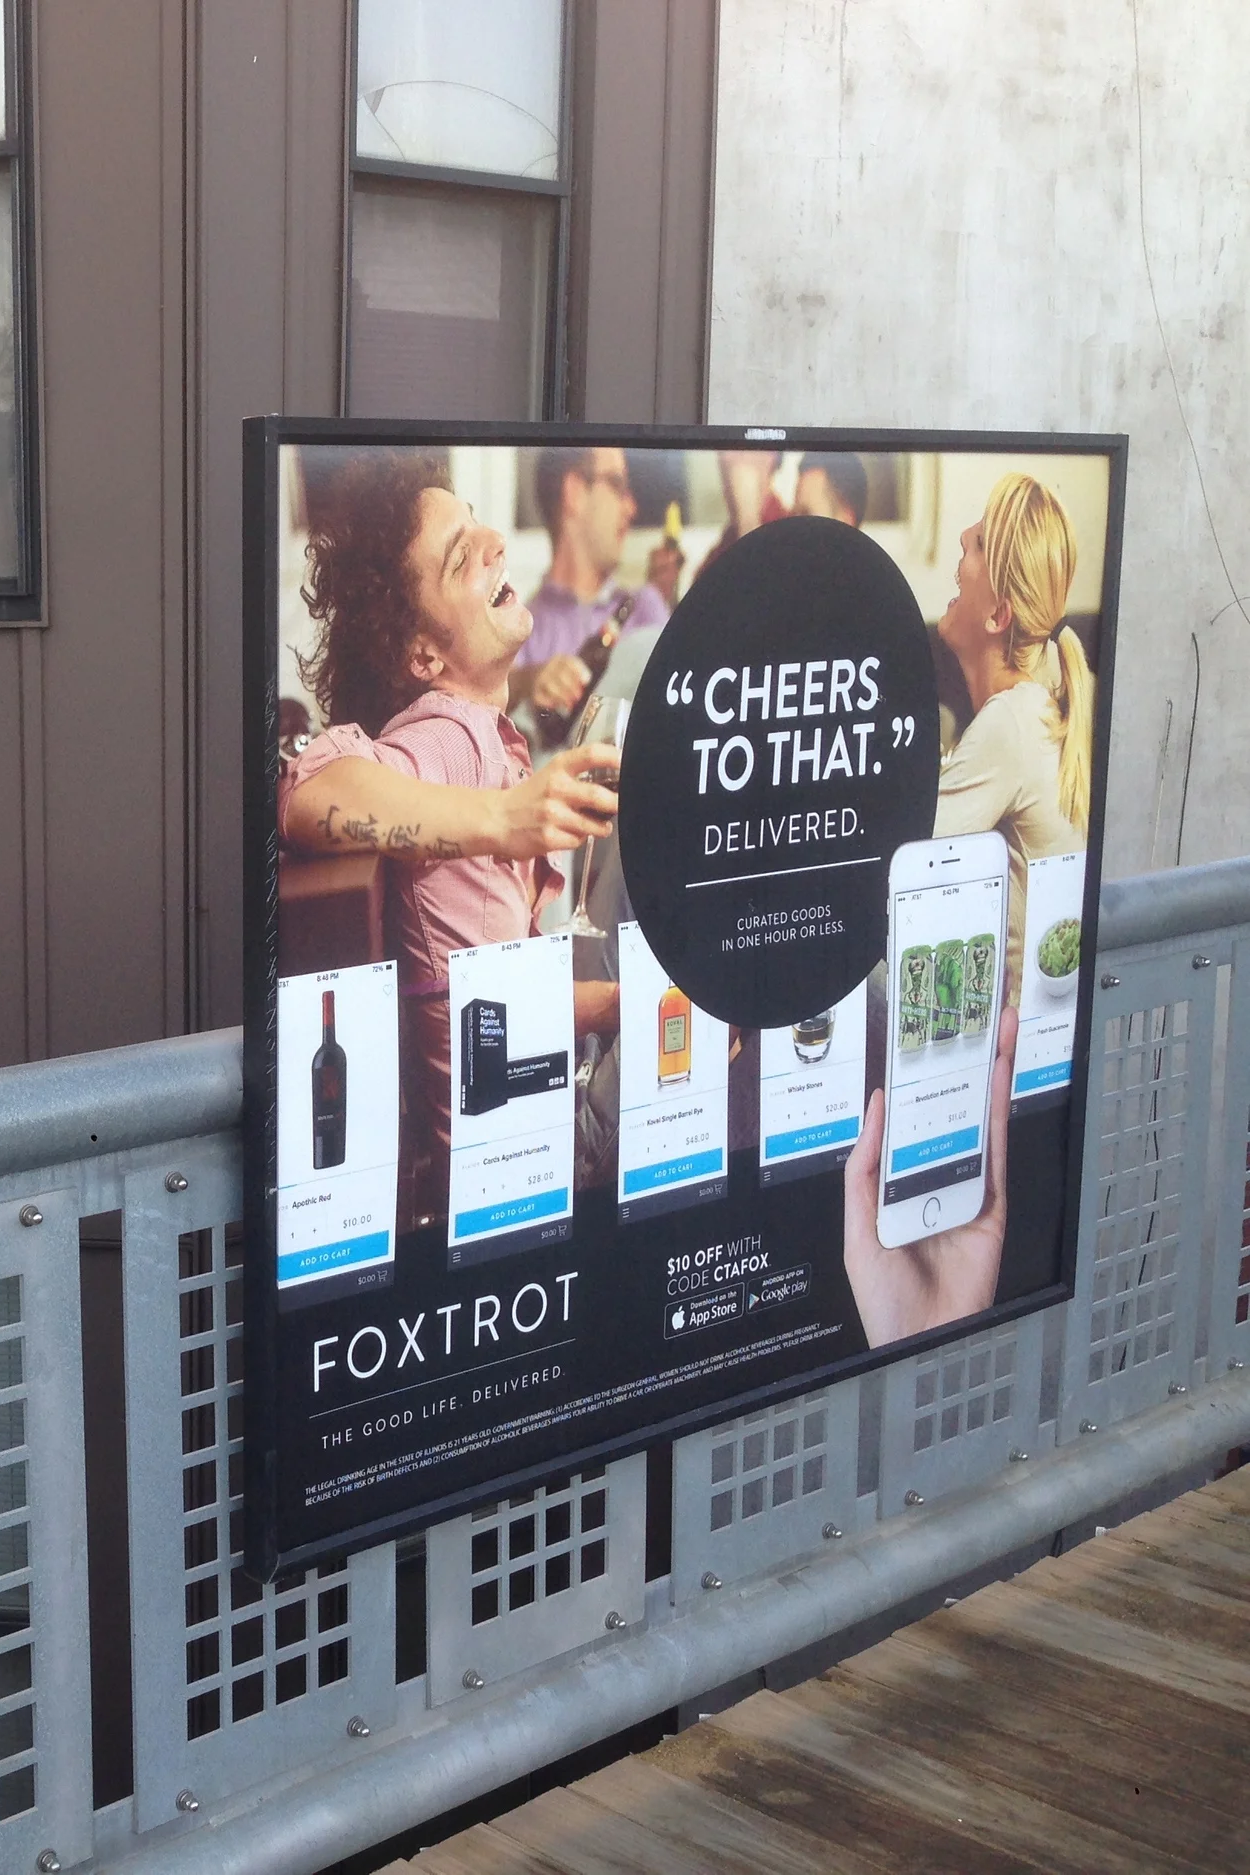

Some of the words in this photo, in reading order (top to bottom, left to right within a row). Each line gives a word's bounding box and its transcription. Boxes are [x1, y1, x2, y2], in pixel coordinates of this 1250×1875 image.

[692, 735, 754, 794] TO
[704, 807, 865, 855] DELIVERED.
[737, 912, 788, 930] CURATED
[792, 904, 831, 922] GOODS
[722, 938, 733, 952] IN
[737, 934, 760, 948] ONE
[764, 928, 796, 944] HOUR
[800, 925, 816, 938] OR
[820, 920, 846, 936] LESS.
[292, 1196, 317, 1210] Apothic
[318, 1194, 332, 1202] Red
[342, 1214, 372, 1230] $10.00
[300, 1256, 317, 1267] ADD
[331, 1248, 350, 1260] CART
[667, 1254, 690, 1276] $10
[694, 1244, 722, 1266] OFF
[727, 1234, 762, 1258] WITH
[667, 1269, 710, 1296] CODE
[760, 1283, 791, 1302] Google
[791, 1280, 808, 1296] play
[762, 1274, 785, 1287] ANDROID
[786, 1272, 796, 1282] APP
[690, 1295, 718, 1310] Download
[719, 1294, 727, 1302] on
[728, 1290, 738, 1299] the
[689, 1311, 710, 1326] App
[712, 1302, 738, 1318] Store
[313, 1272, 579, 1392] FOXTROT
[321, 1428, 353, 1450] THE
[362, 1410, 413, 1436] GOOD
[422, 1396, 464, 1419] LIFE.
[472, 1365, 566, 1404] DELIVERED.
[305, 1484, 316, 1495] THE
[317, 1478, 335, 1491] LEGAL
[337, 1468, 365, 1484] DRINKING
[366, 1464, 377, 1475] AGE
[379, 1462, 385, 1470] IN
[386, 1458, 397, 1468] THE
[398, 1452, 414, 1464] STATE
[415, 1450, 422, 1459] OF
[454, 1438, 460, 1446] 21
[460, 1432, 478, 1444] YEARS
[305, 1490, 330, 1506] BECAUSE
[332, 1487, 340, 1497] OF
[341, 1483, 352, 1494] THE
[354, 1478, 366, 1490] RISK
[367, 1475, 375, 1485] OF
[394, 1461, 418, 1476] DEFECTS
[419, 1457, 432, 1468] AND
[482, 1438, 490, 1447] OF
